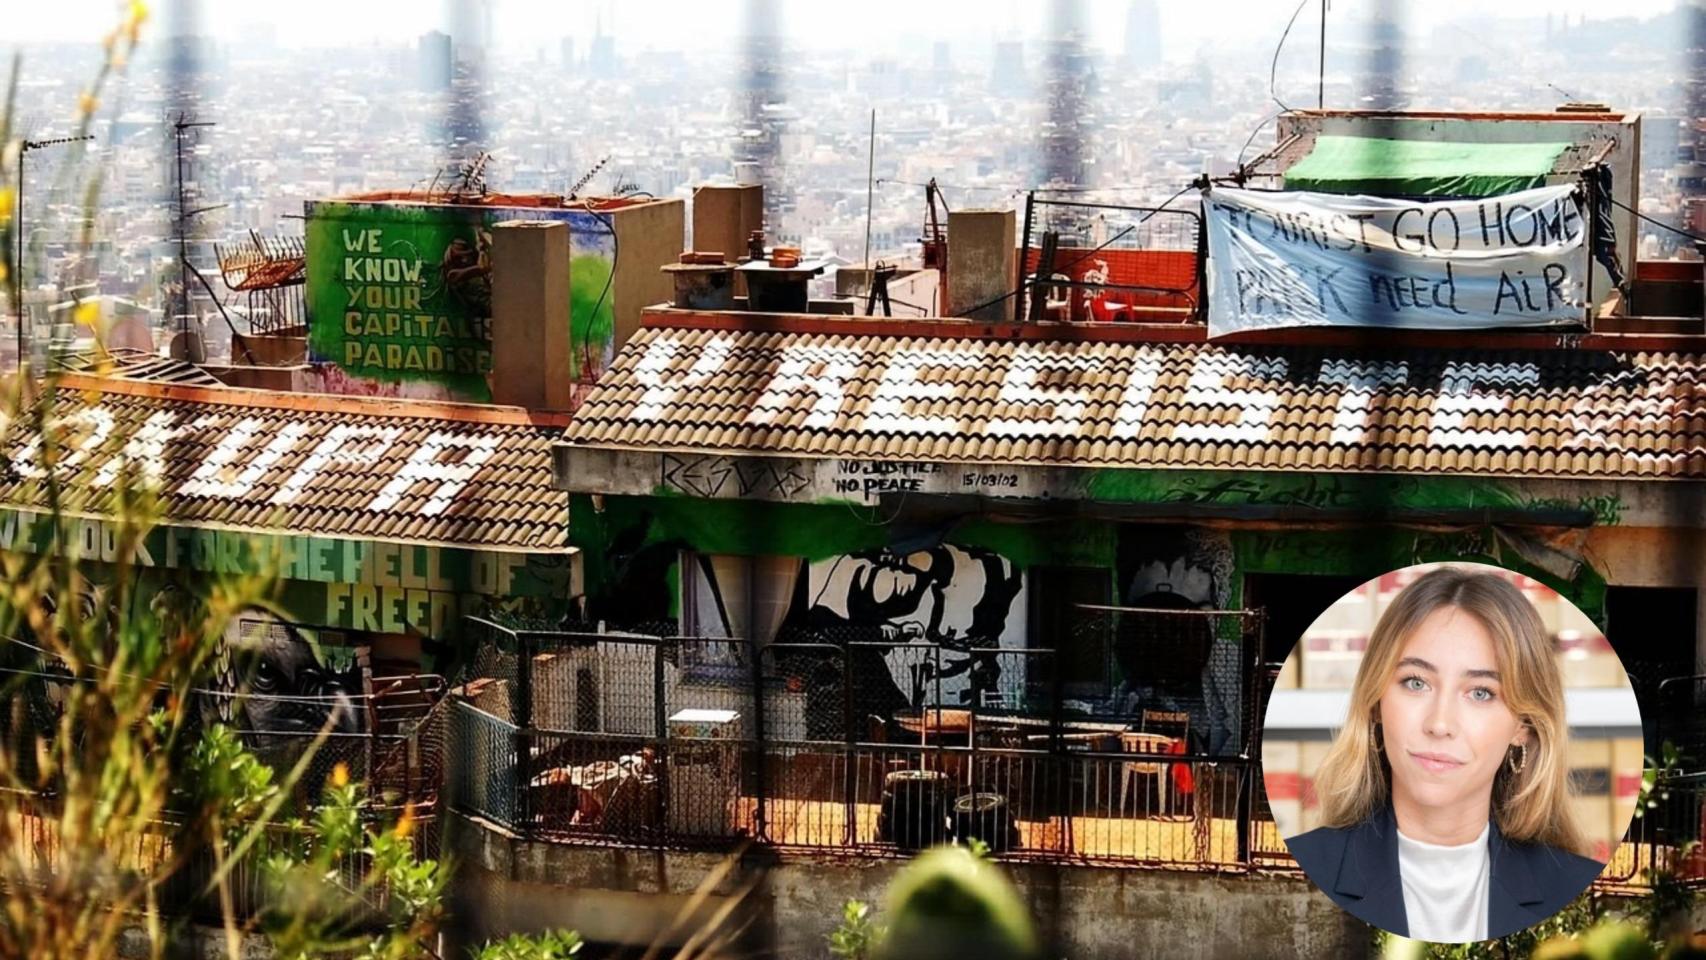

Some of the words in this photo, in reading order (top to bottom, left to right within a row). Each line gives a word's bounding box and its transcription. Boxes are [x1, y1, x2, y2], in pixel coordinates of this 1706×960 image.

[1212, 202, 1376, 254] TOURIST
[1391, 207, 1460, 254] GO
[1478, 196, 1581, 248] HOME
[342, 228, 382, 254] WE
[344, 256, 421, 284] KNOW
[346, 284, 422, 311] YOUR
[631, 335, 737, 423] Y
[837, 460, 860, 475] NO
[962, 473, 1019, 488] 15/03/02
[835, 478, 860, 493] NO
[863, 478, 925, 501] PEACE
[166, 525, 244, 574] FOR
[342, 539, 457, 591] HELL
[470, 550, 528, 598] OF
